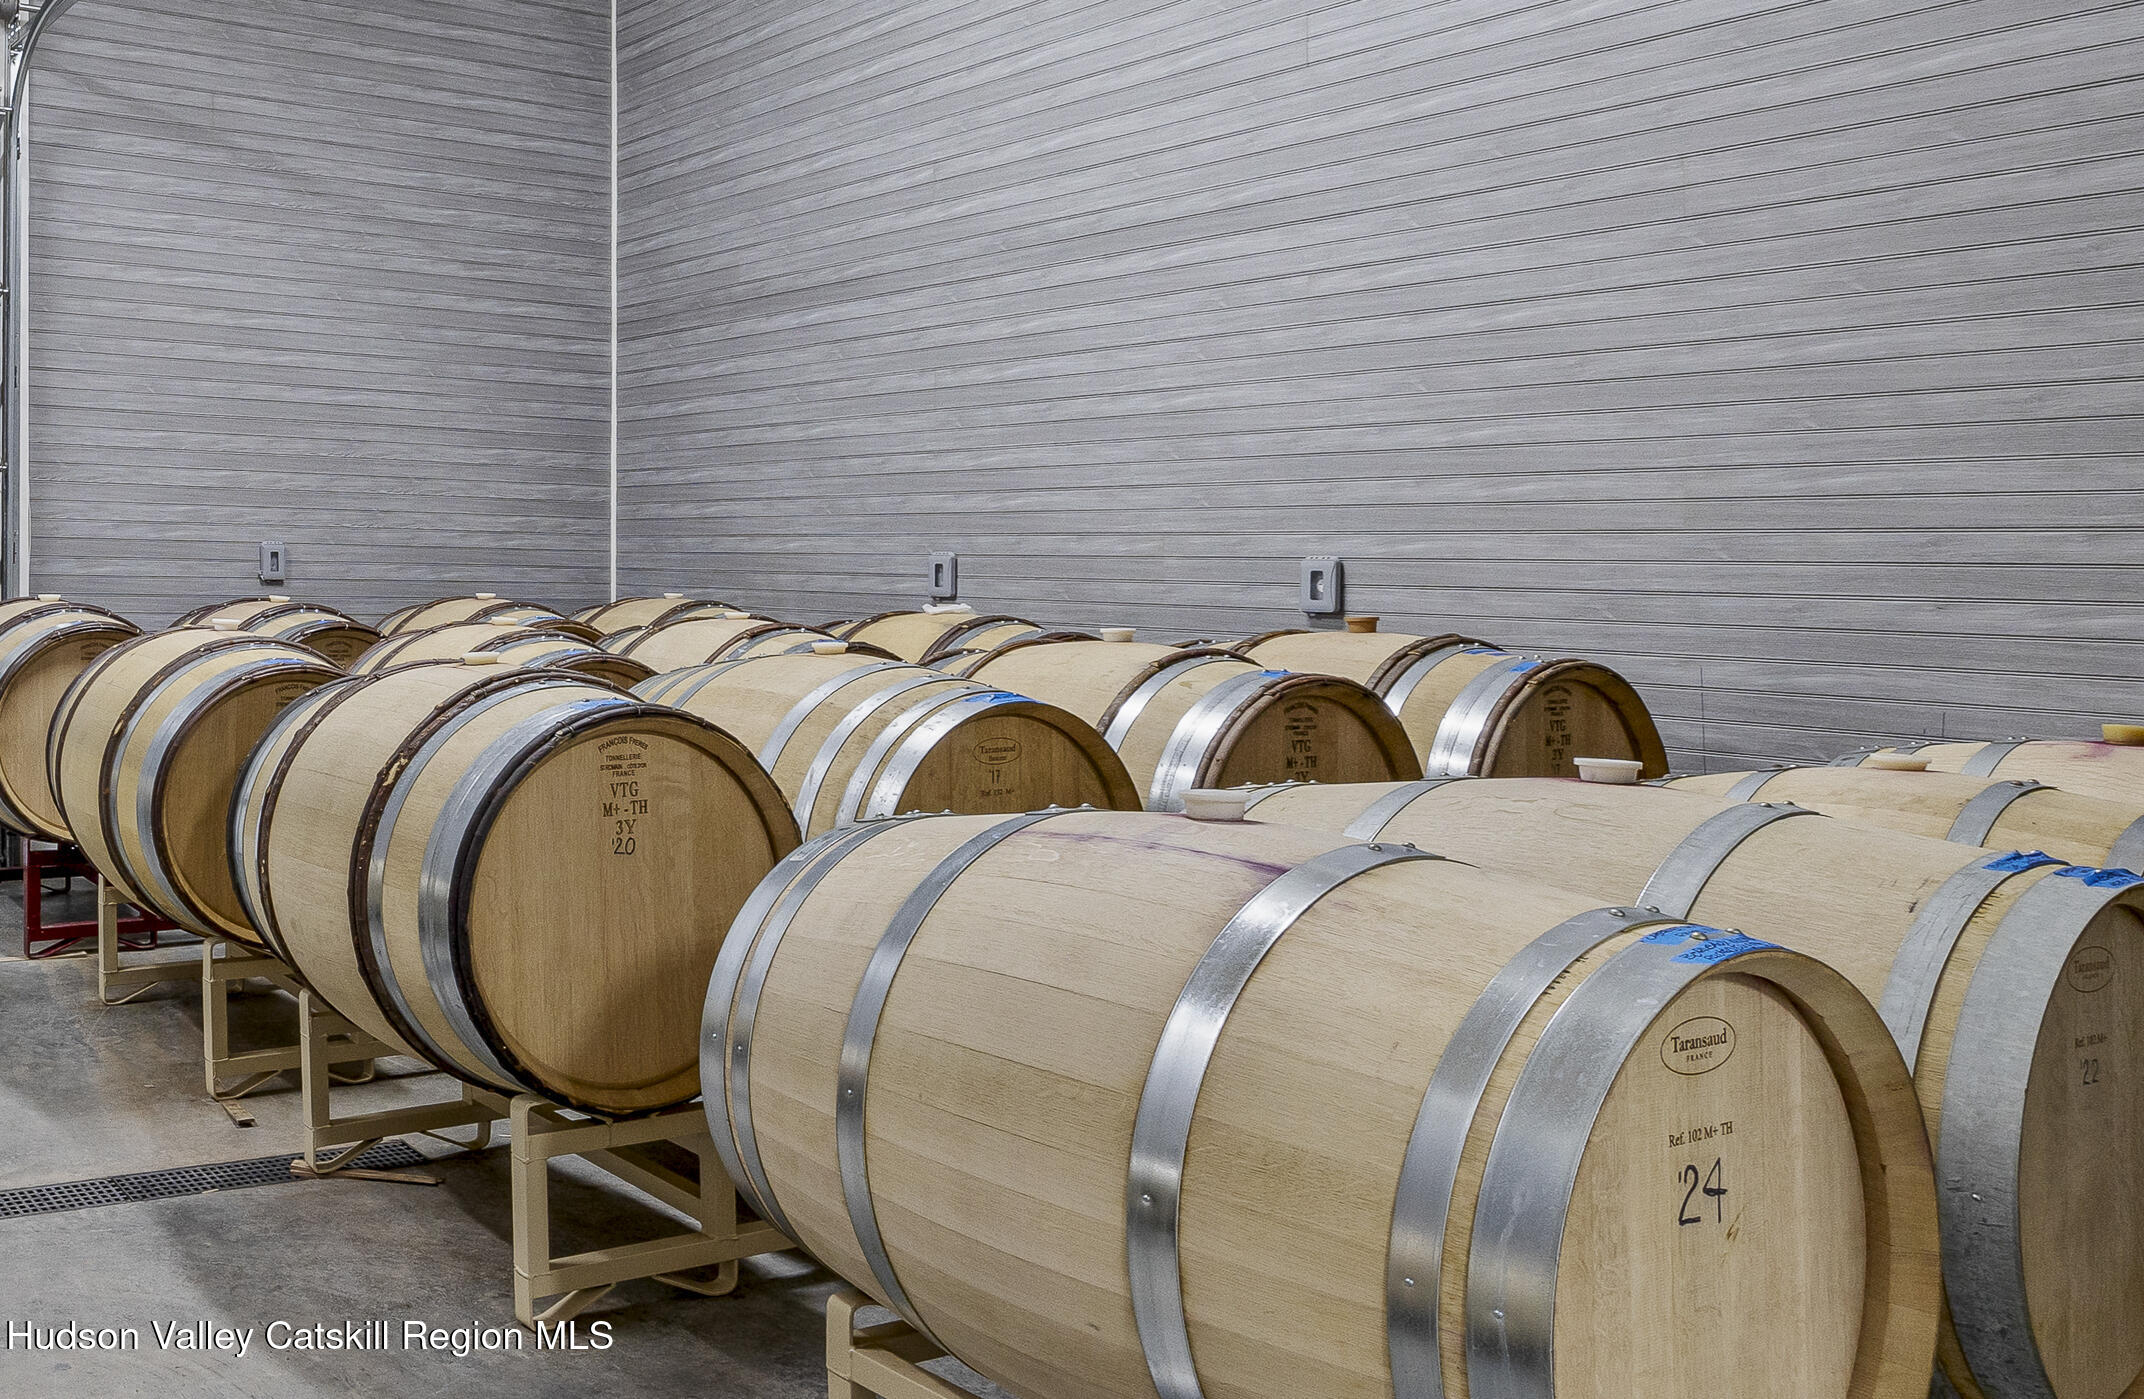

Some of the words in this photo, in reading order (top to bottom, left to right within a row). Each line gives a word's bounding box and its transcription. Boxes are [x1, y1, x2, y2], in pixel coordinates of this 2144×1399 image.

[1291, 739, 1312, 752] VTG
[612, 770, 636, 778] FRANCE
[610, 781, 640, 798] VTG
[615, 819, 637, 836] 3Y
[1670, 1027, 1728, 1053] Taransaud
[1686, 1050, 1713, 1062] FRANCE
[1668, 1132, 1685, 1148] Ref.
[1688, 1128, 1702, 1143] 102
[1704, 1125, 1719, 1139] M+
[1720, 1121, 1733, 1136] TH
[1678, 1157, 1728, 1226] '24
